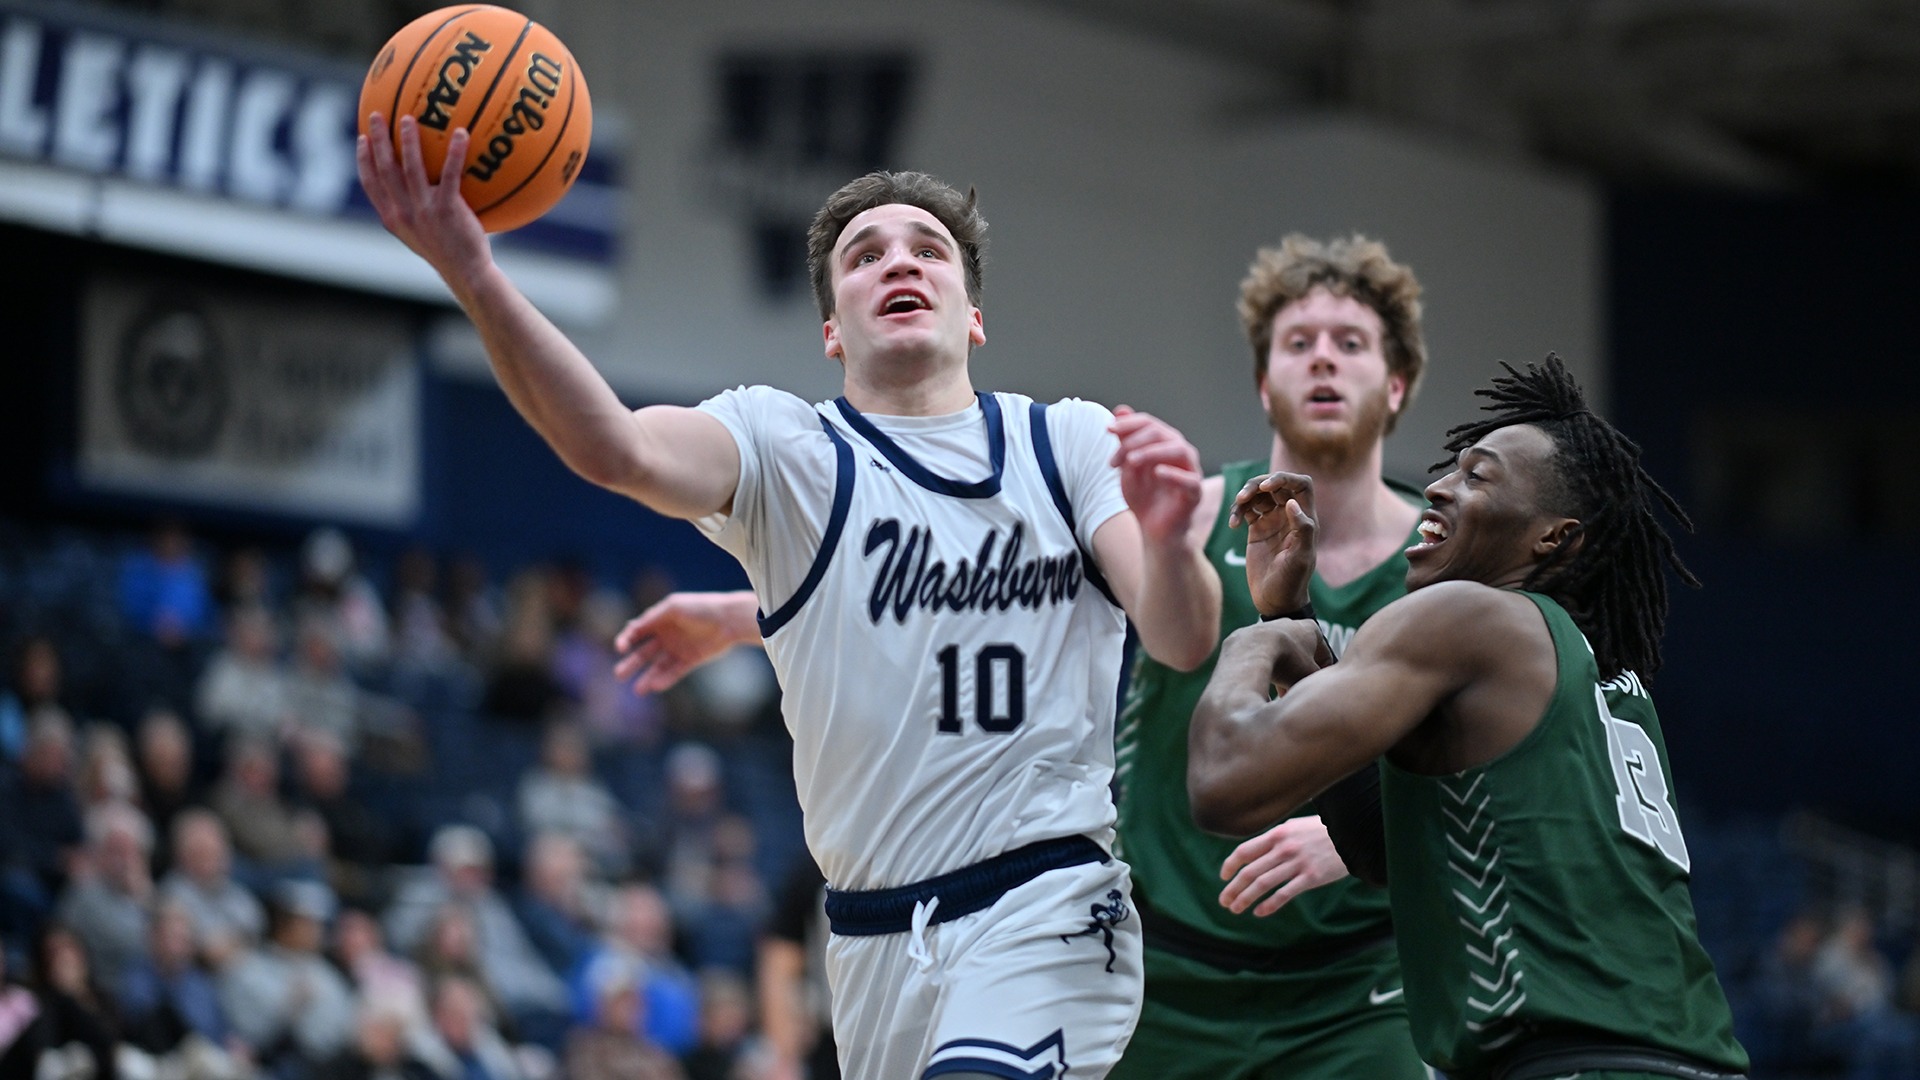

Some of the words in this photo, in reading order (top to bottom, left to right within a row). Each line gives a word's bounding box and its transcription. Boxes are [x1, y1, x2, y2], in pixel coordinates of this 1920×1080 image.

[417, 31, 493, 132] NCAA
[465, 52, 564, 183] Wilson
[862, 516, 1083, 627] Washburn
[936, 641, 1028, 736] 10
[1594, 682, 1691, 874] 13
